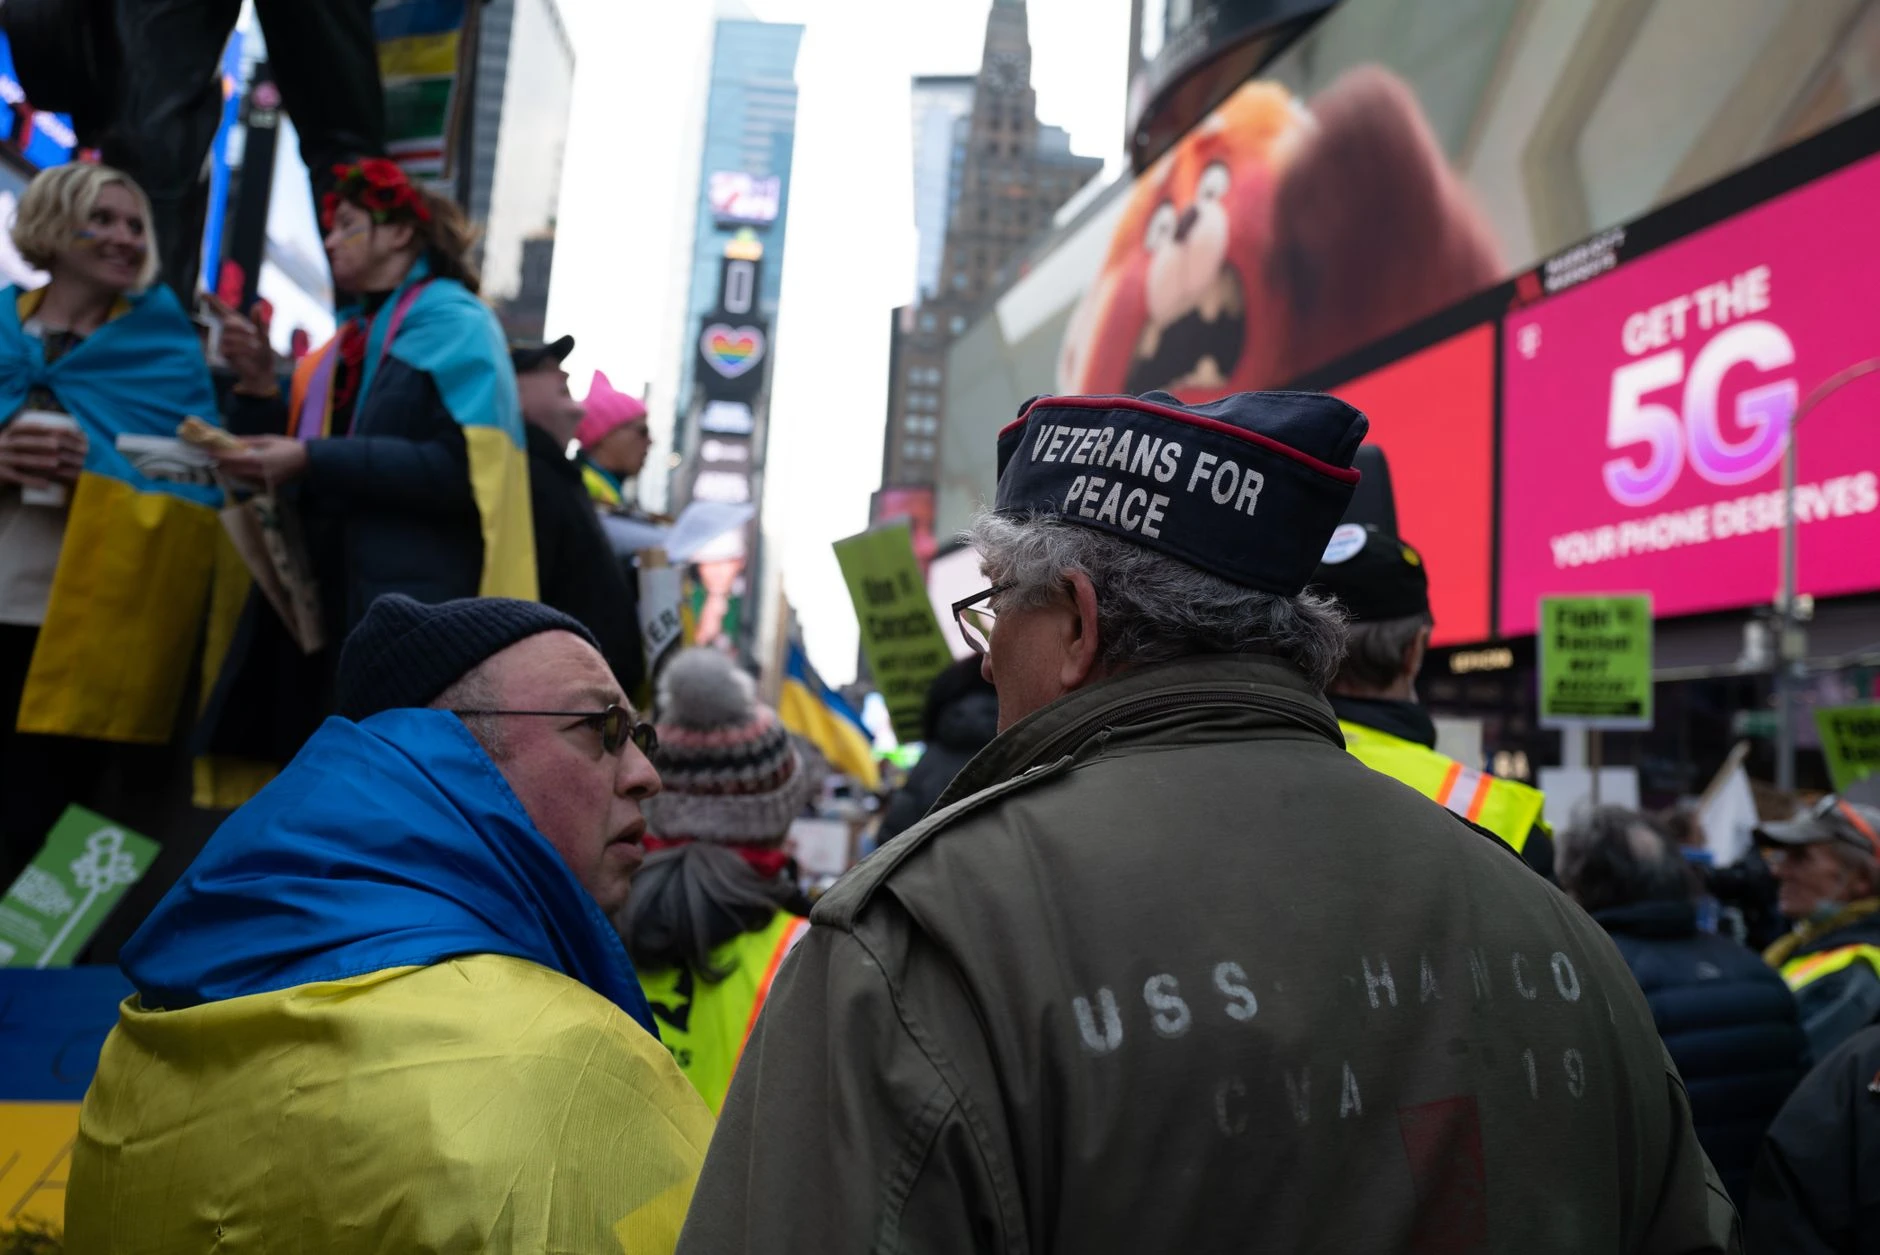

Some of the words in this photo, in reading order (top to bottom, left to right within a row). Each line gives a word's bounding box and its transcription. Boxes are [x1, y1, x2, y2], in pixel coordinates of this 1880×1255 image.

[1621, 294, 1690, 356] GET
[1692, 264, 1772, 330] THE
[1603, 320, 1798, 507] 5G
[1031, 424, 1183, 484] VETERANS
[1186, 451, 1265, 516] FOR
[1062, 475, 1170, 539] PEACE
[1551, 524, 1619, 569] YOUR
[1619, 504, 1711, 557] PHONE
[1712, 470, 1879, 540] DESERVES
[1072, 960, 1259, 1054] USS
[1215, 1059, 1364, 1137] CVA
[1520, 1046, 1586, 1100] 19
